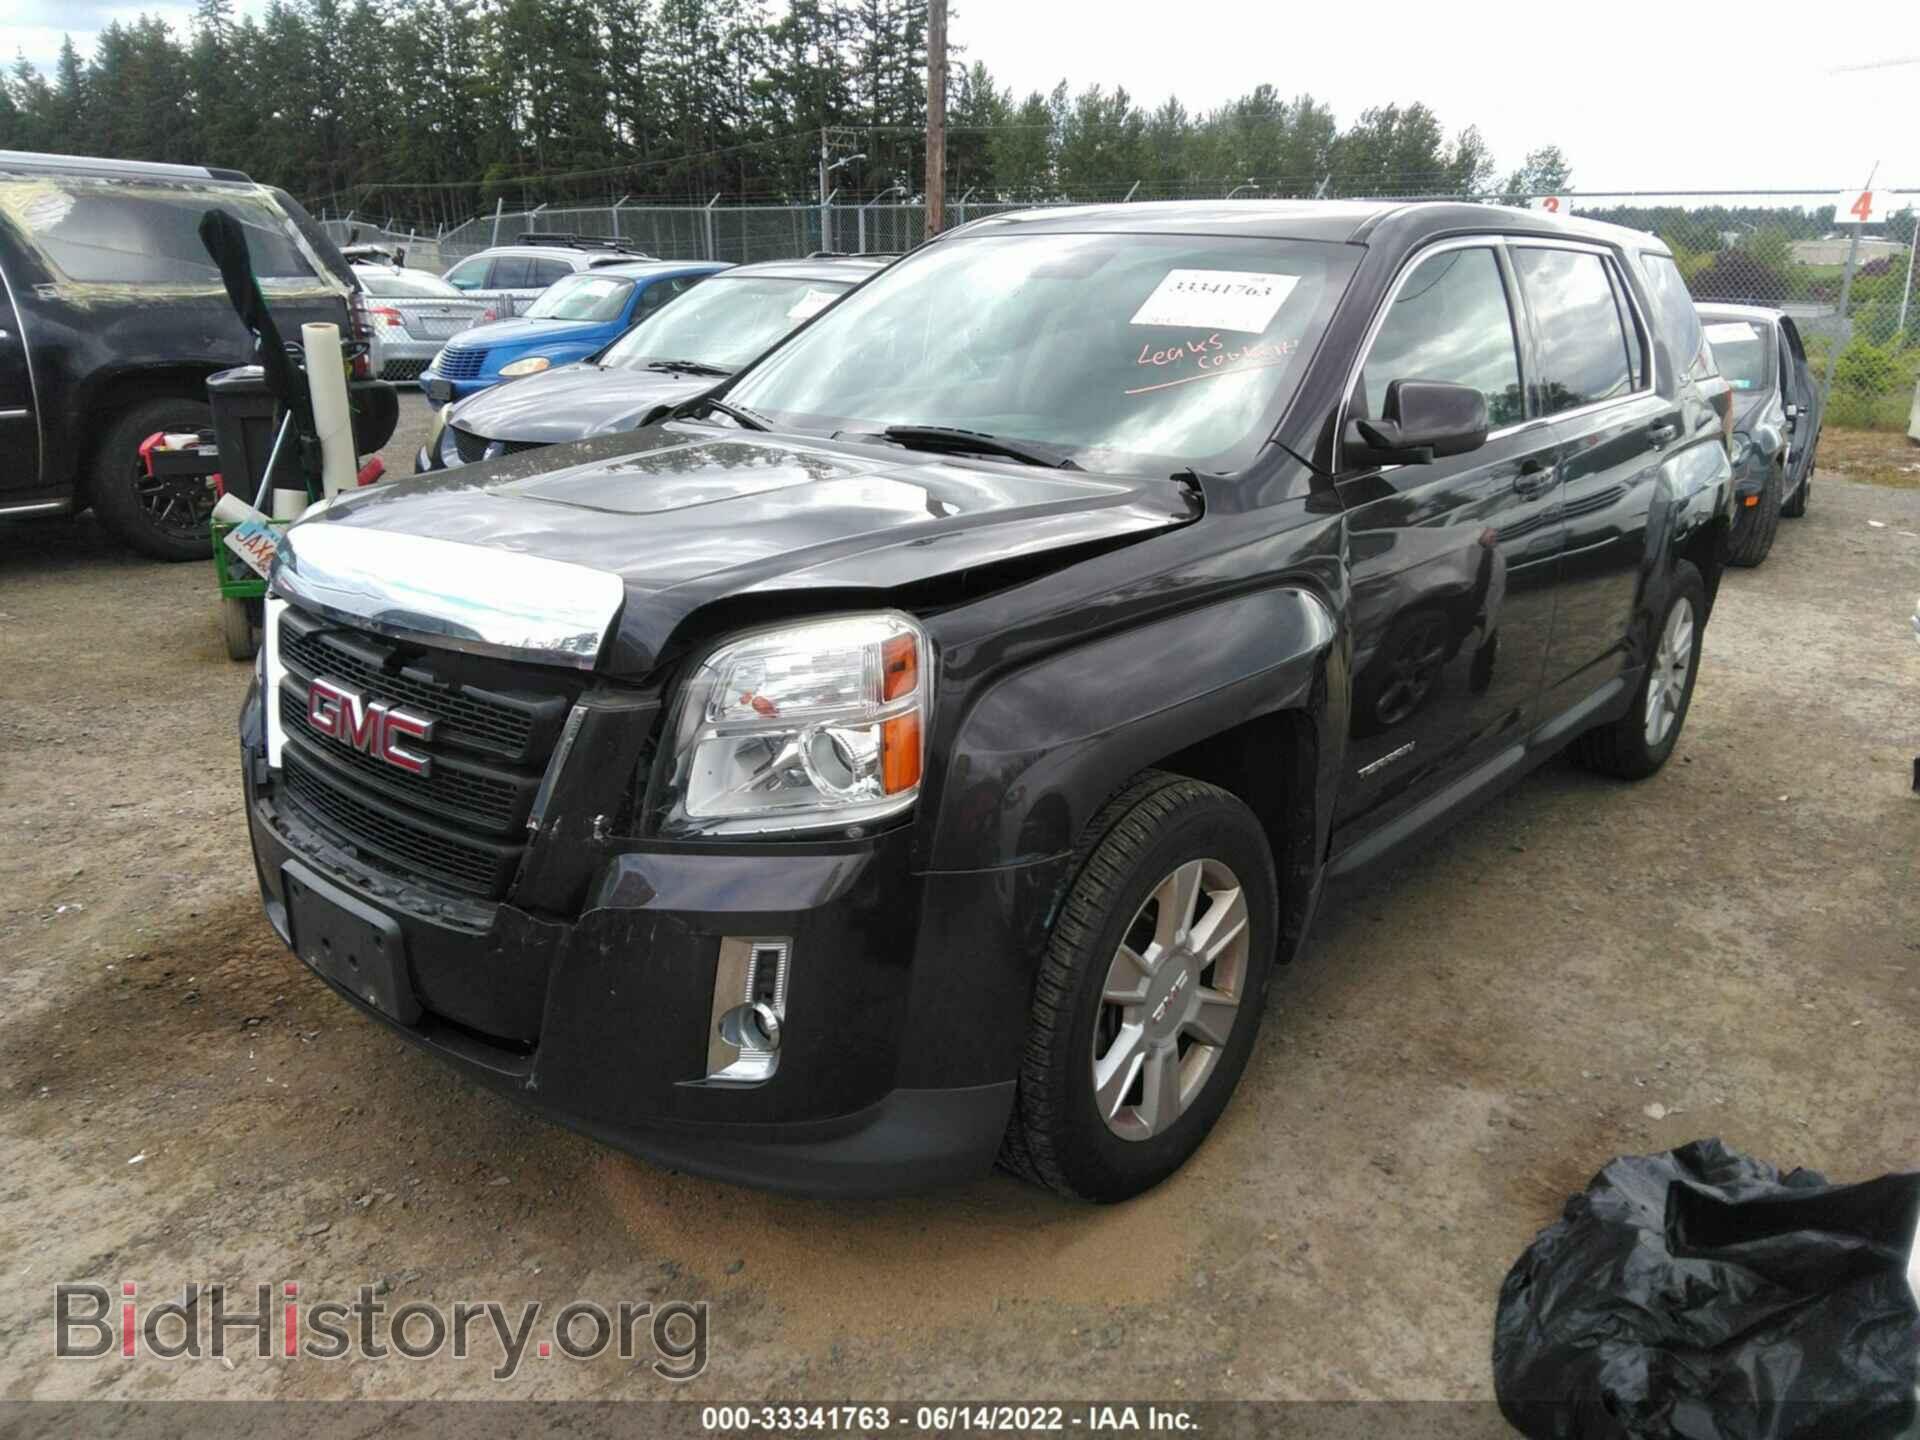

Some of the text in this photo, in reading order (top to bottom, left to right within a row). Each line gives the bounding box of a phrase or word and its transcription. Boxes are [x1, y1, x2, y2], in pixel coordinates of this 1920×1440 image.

[1542, 197, 1559, 213] 3
[1851, 191, 1872, 221] 4
[1168, 281, 1272, 297] 33341763
[308, 678, 433, 777] GMC
